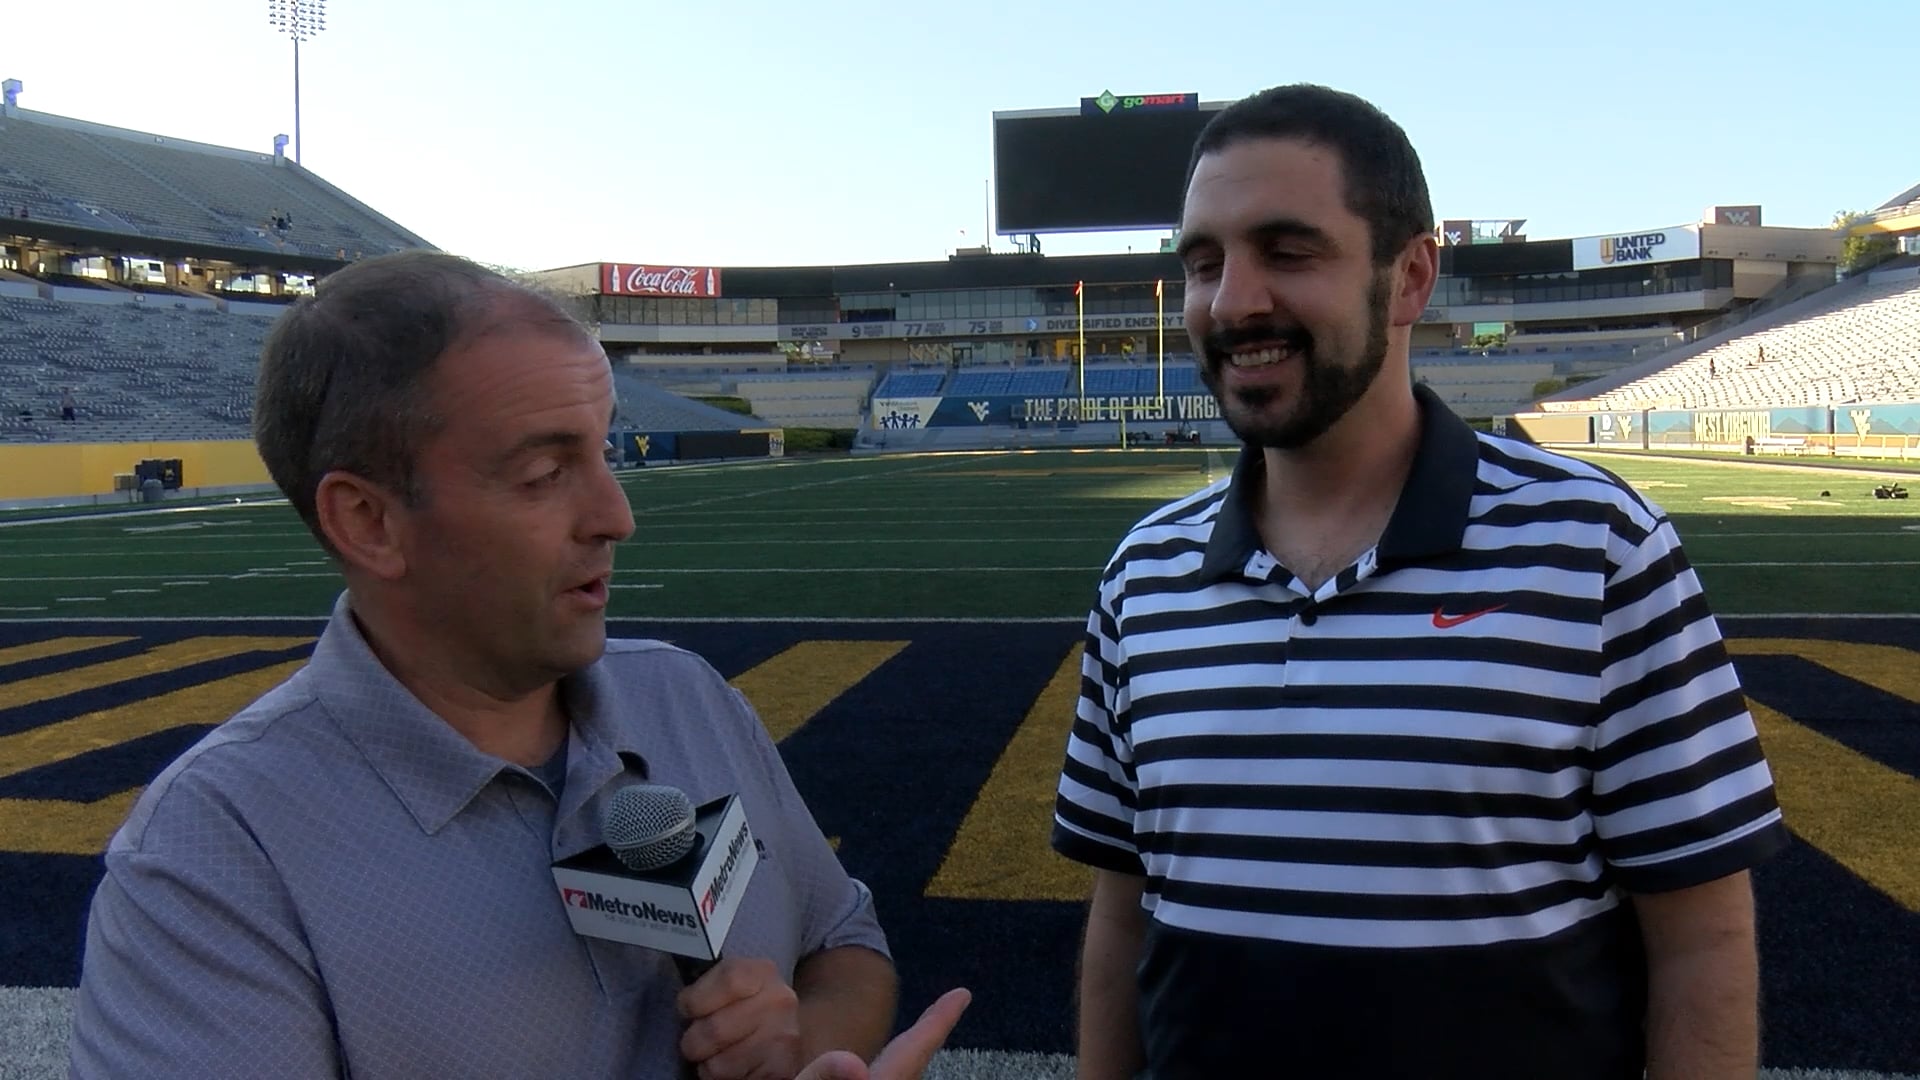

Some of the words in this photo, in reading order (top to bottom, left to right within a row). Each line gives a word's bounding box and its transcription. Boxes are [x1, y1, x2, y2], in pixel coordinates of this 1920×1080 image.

[1123, 94, 1185, 108] gomart
[1616, 233, 1665, 249] UNITED
[1616, 247, 1652, 262] BANK
[904, 323, 923, 336] 77
[968, 321, 987, 334] 75
[1047, 318, 1122, 330] DIVESIFIED
[1125, 316, 1174, 328] ENERY
[851, 326, 861, 338] 9
[1025, 399, 1053, 421] THE
[1057, 397, 1106, 421] PRIDE
[1109, 397, 1129, 420] OF
[1132, 396, 1174, 420] WEST
[1695, 412, 1721, 442] WEST
[710, 821, 749, 906] MetroNews
[585, 890, 698, 929] MetroNews
